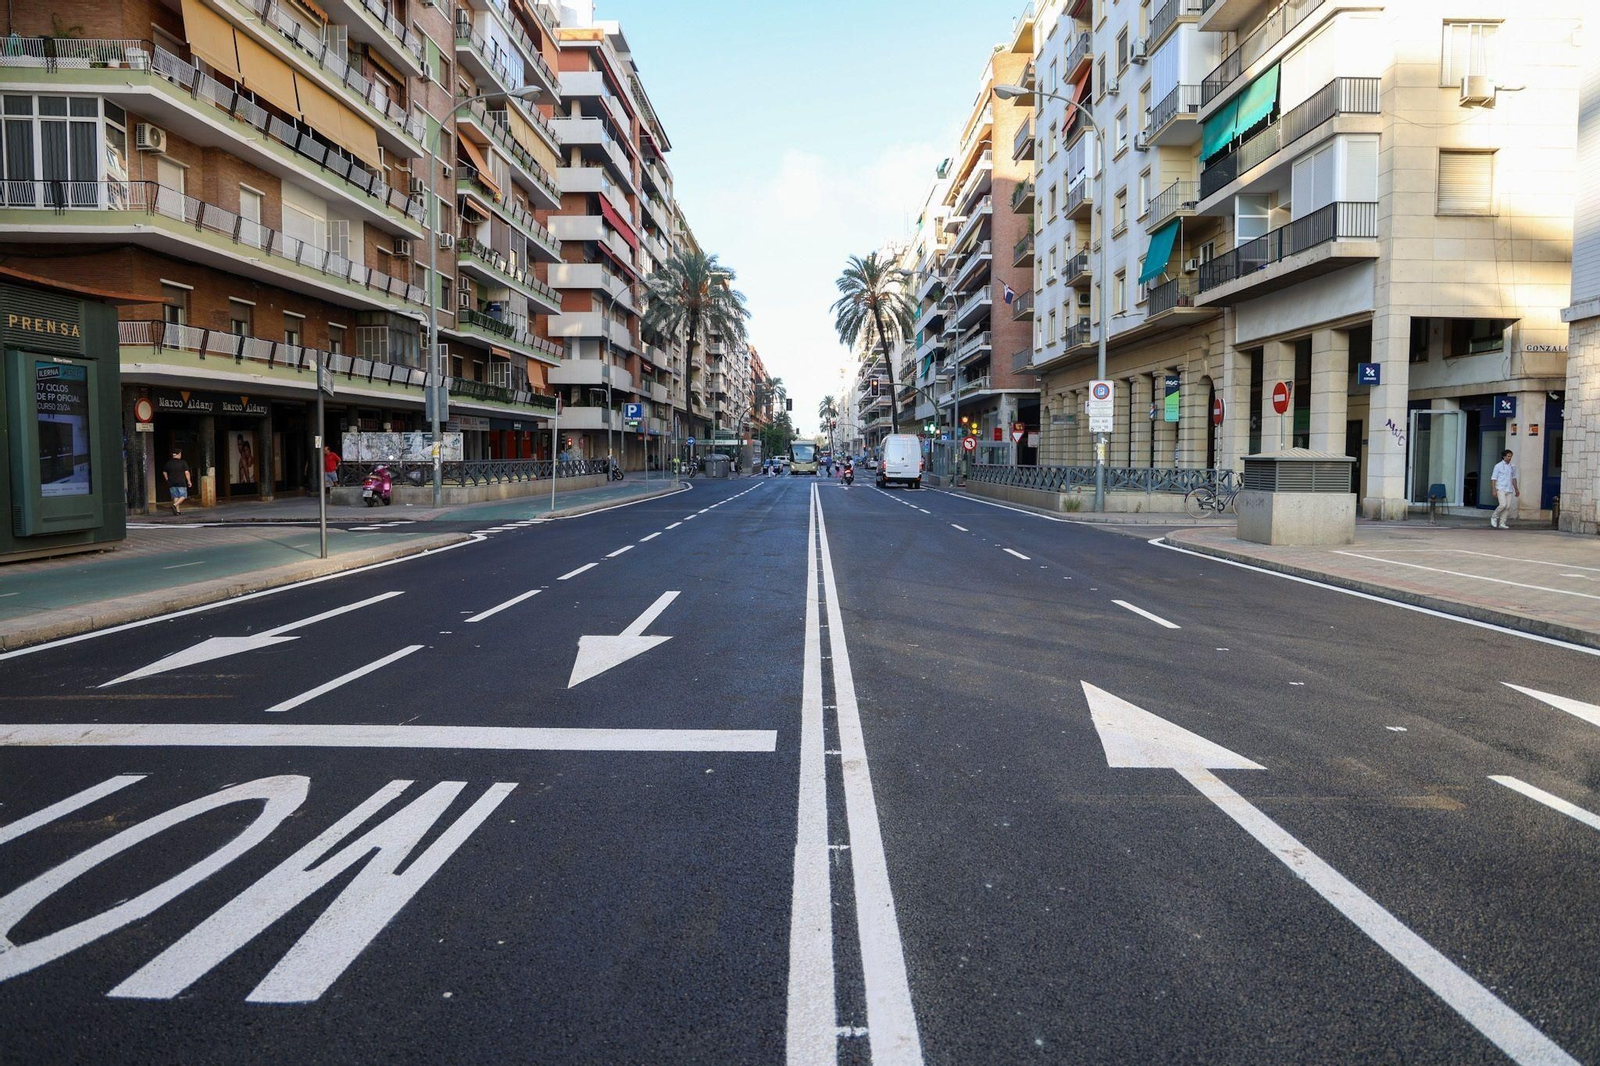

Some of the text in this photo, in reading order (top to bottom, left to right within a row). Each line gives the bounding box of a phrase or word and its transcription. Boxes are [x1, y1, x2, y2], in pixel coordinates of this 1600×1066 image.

[8, 313, 81, 338] PRENSA
[38, 368, 59, 377] ILERNA
[36, 383, 69, 393] 17 CICLOS
[36, 392, 81, 403] DE FP OFICIAL
[37, 402, 55, 410] CURSO
[158, 397, 183, 408] Marco
[187, 399, 214, 412] Aldany
[222, 401, 243, 412] Marco
[245, 404, 269, 415] Aldany
[627, 404, 638, 417] P
[0, 774, 519, 1004] MO
